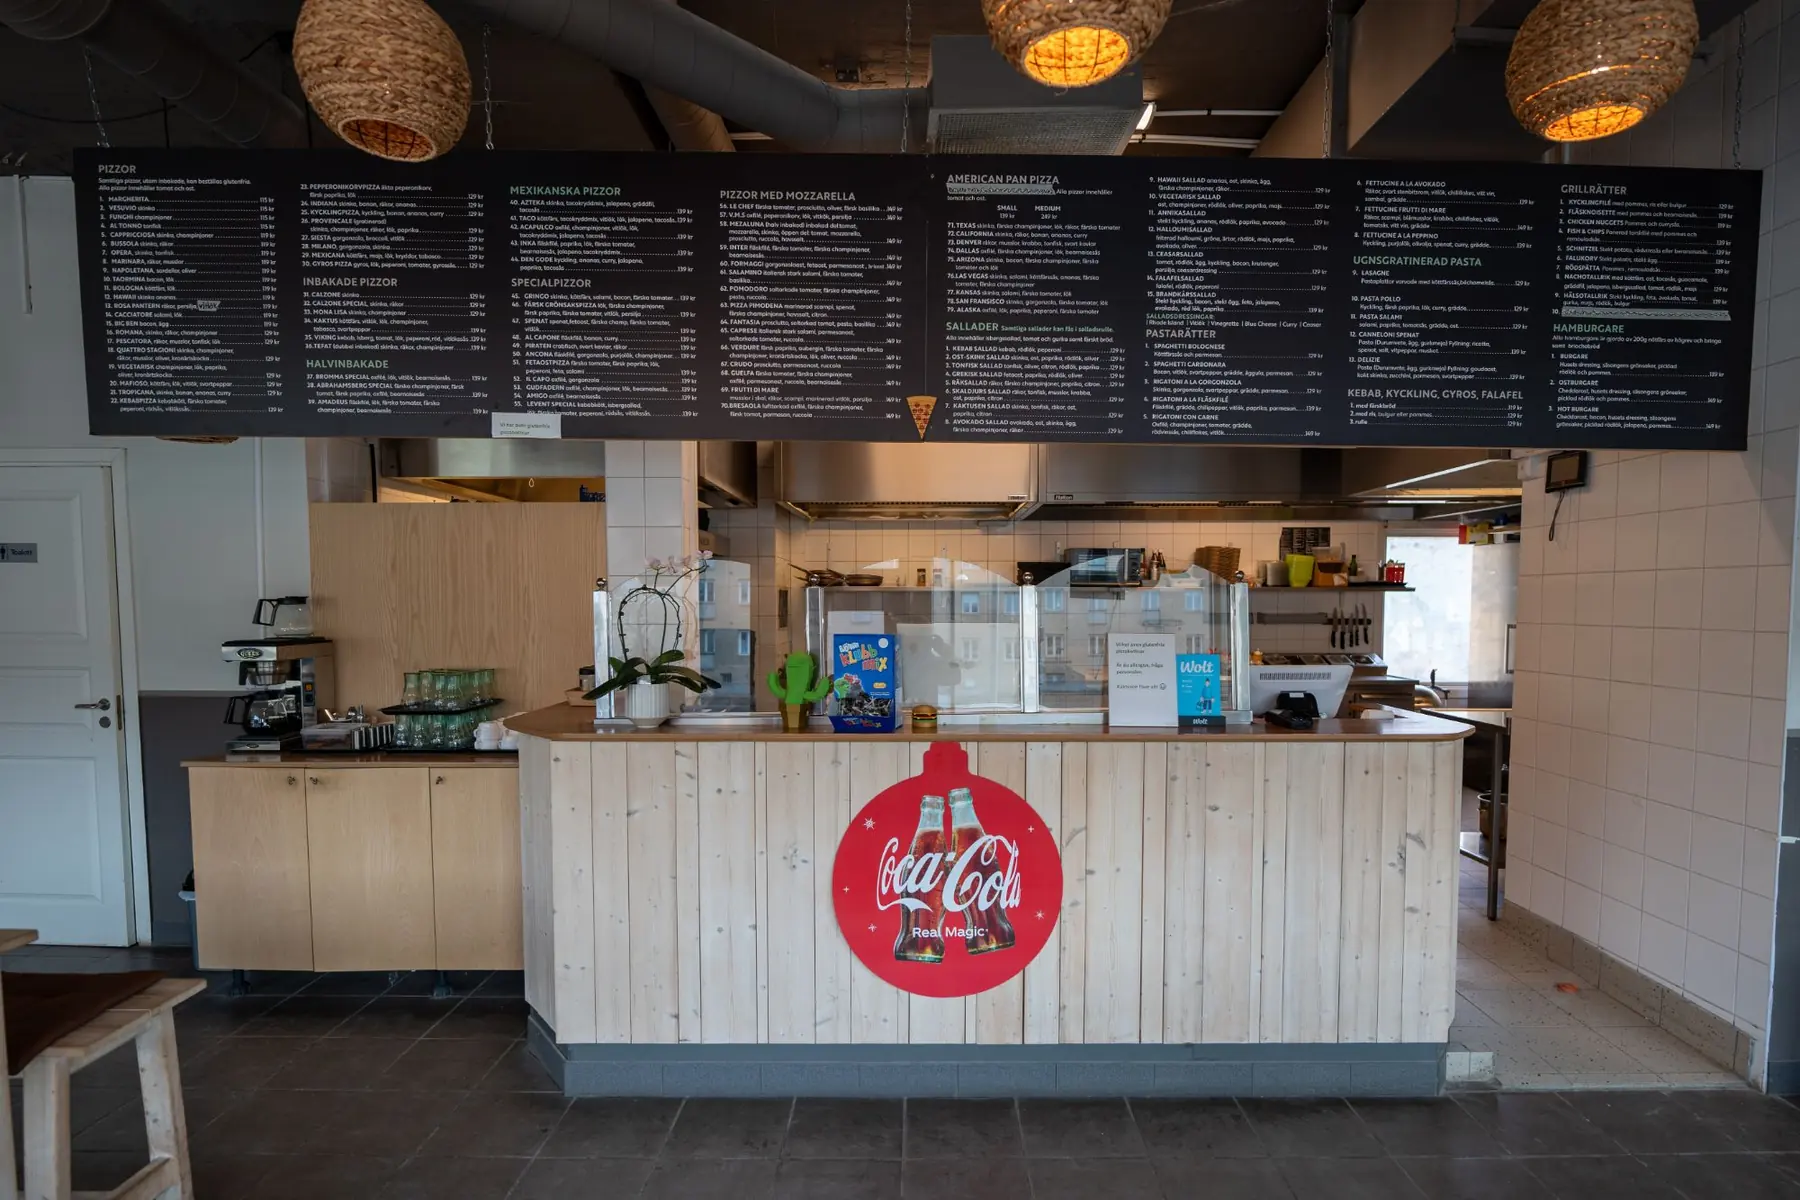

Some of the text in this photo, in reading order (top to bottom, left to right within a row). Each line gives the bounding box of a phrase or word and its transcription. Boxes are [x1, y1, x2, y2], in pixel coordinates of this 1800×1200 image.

[98, 165, 136, 173] PIZZOR
[947, 175, 1059, 184] AMERICAN PAN PIZZA
[510, 186, 620, 195] MEXIKANSKA PIZZOR
[1561, 184, 1626, 194] GRILLRÄTTER
[720, 191, 855, 200] PIZZOR MED MOZZARELLA
[1354, 256, 1481, 266] UGNSGRATINERAD PASTA
[304, 278, 397, 286] INBAKADE PIZZOR
[512, 278, 591, 287] SPECIALPIZZOR
[946, 322, 998, 330] SALLADER
[1554, 324, 1624, 332] HAMBURGARE
[1146, 328, 1216, 338] PASTARÄTTER
[307, 360, 388, 368] HALVINBAKADE
[1348, 389, 1523, 399] KEBAB, KYCKLING, GYROS, FALAFEL
[1180, 660, 1214, 673] Wolt
[876, 835, 1022, 912] Coca-Cola
[913, 927, 942, 938] Real
